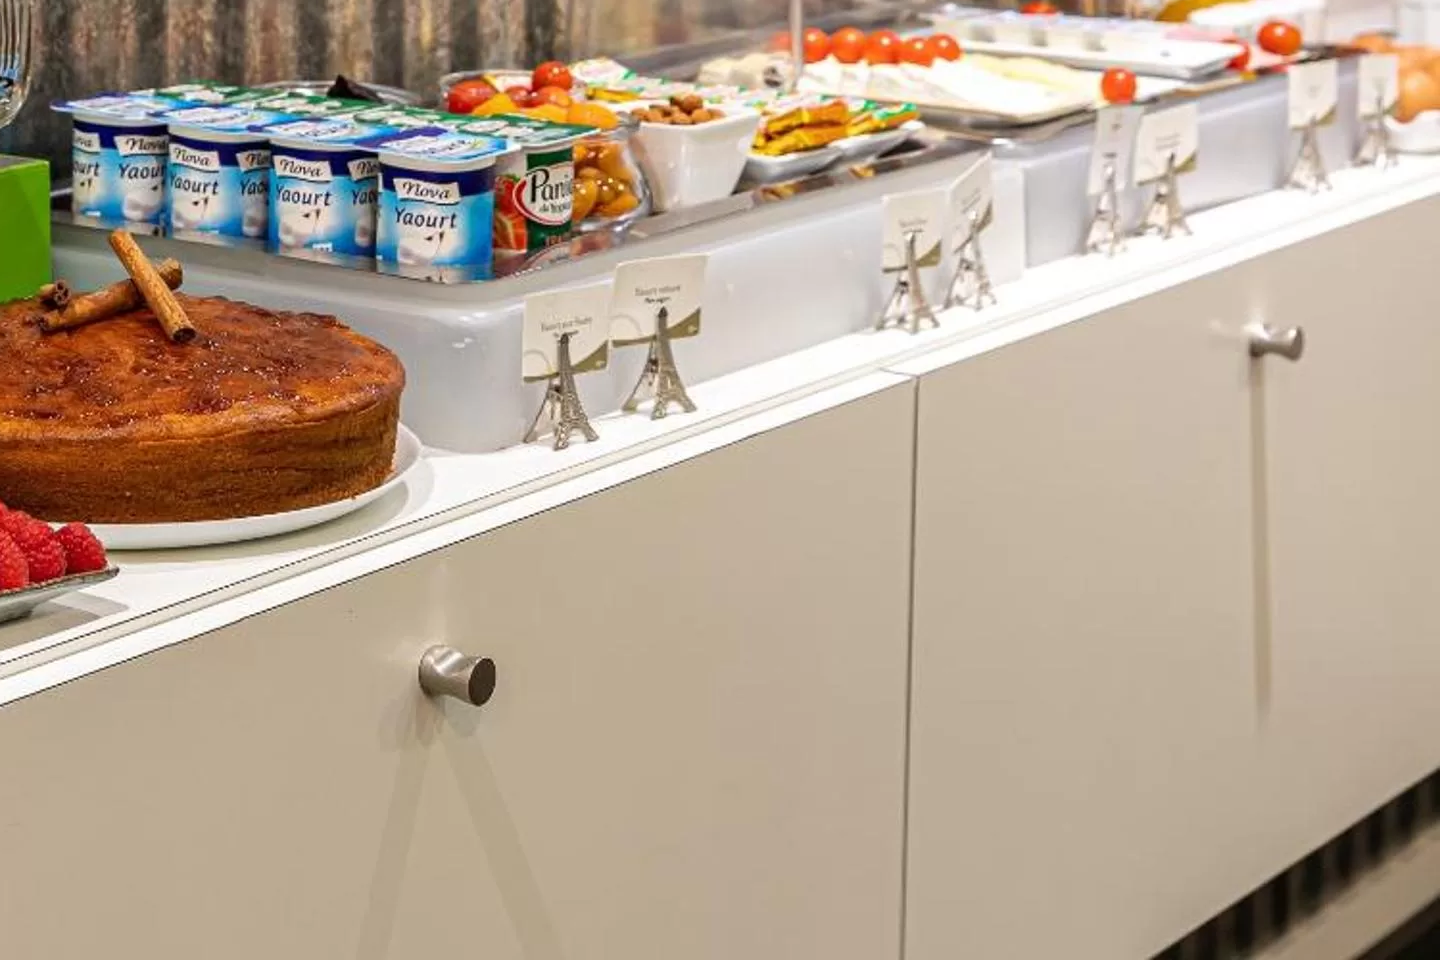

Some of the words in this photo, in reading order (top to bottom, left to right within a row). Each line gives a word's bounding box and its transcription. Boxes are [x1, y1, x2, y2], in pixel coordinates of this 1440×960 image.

[174, 147, 211, 166] Nova
[280, 159, 323, 177] Nova
[168, 173, 219, 195] Yaourt
[402, 181, 452, 200] Nova
[276, 184, 332, 206] Yaourt
[394, 207, 457, 230] Yaourt
